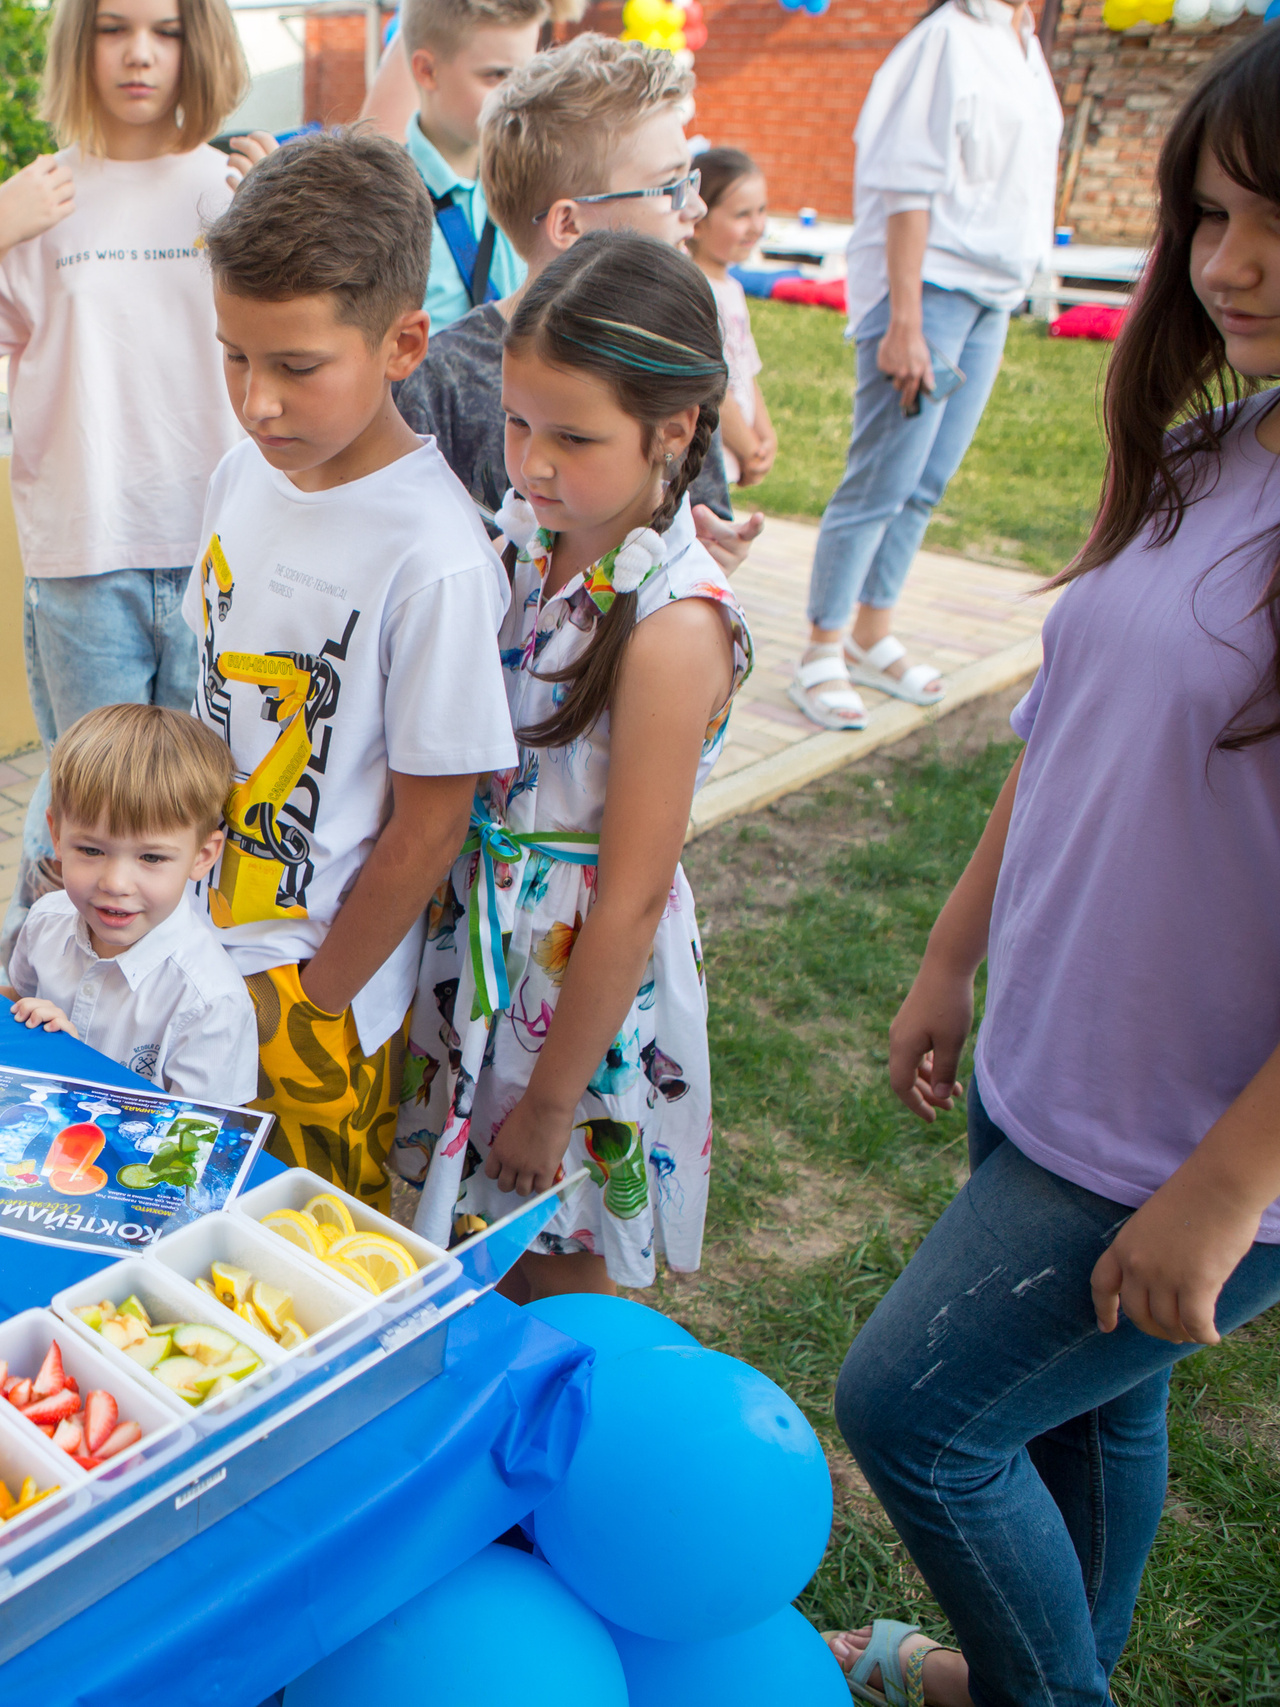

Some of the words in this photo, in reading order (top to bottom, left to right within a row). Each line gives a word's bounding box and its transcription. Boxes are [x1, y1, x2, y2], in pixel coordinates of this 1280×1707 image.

[95, 249, 138, 260] WHO'S
[144, 246, 199, 260] SINGING
[121, 1105, 164, 1115] «САНРАЙЗ»
[131, 1205, 175, 1216] «МОХИТО»
[2, 1204, 163, 1243] КОКТЕЙЛИ
